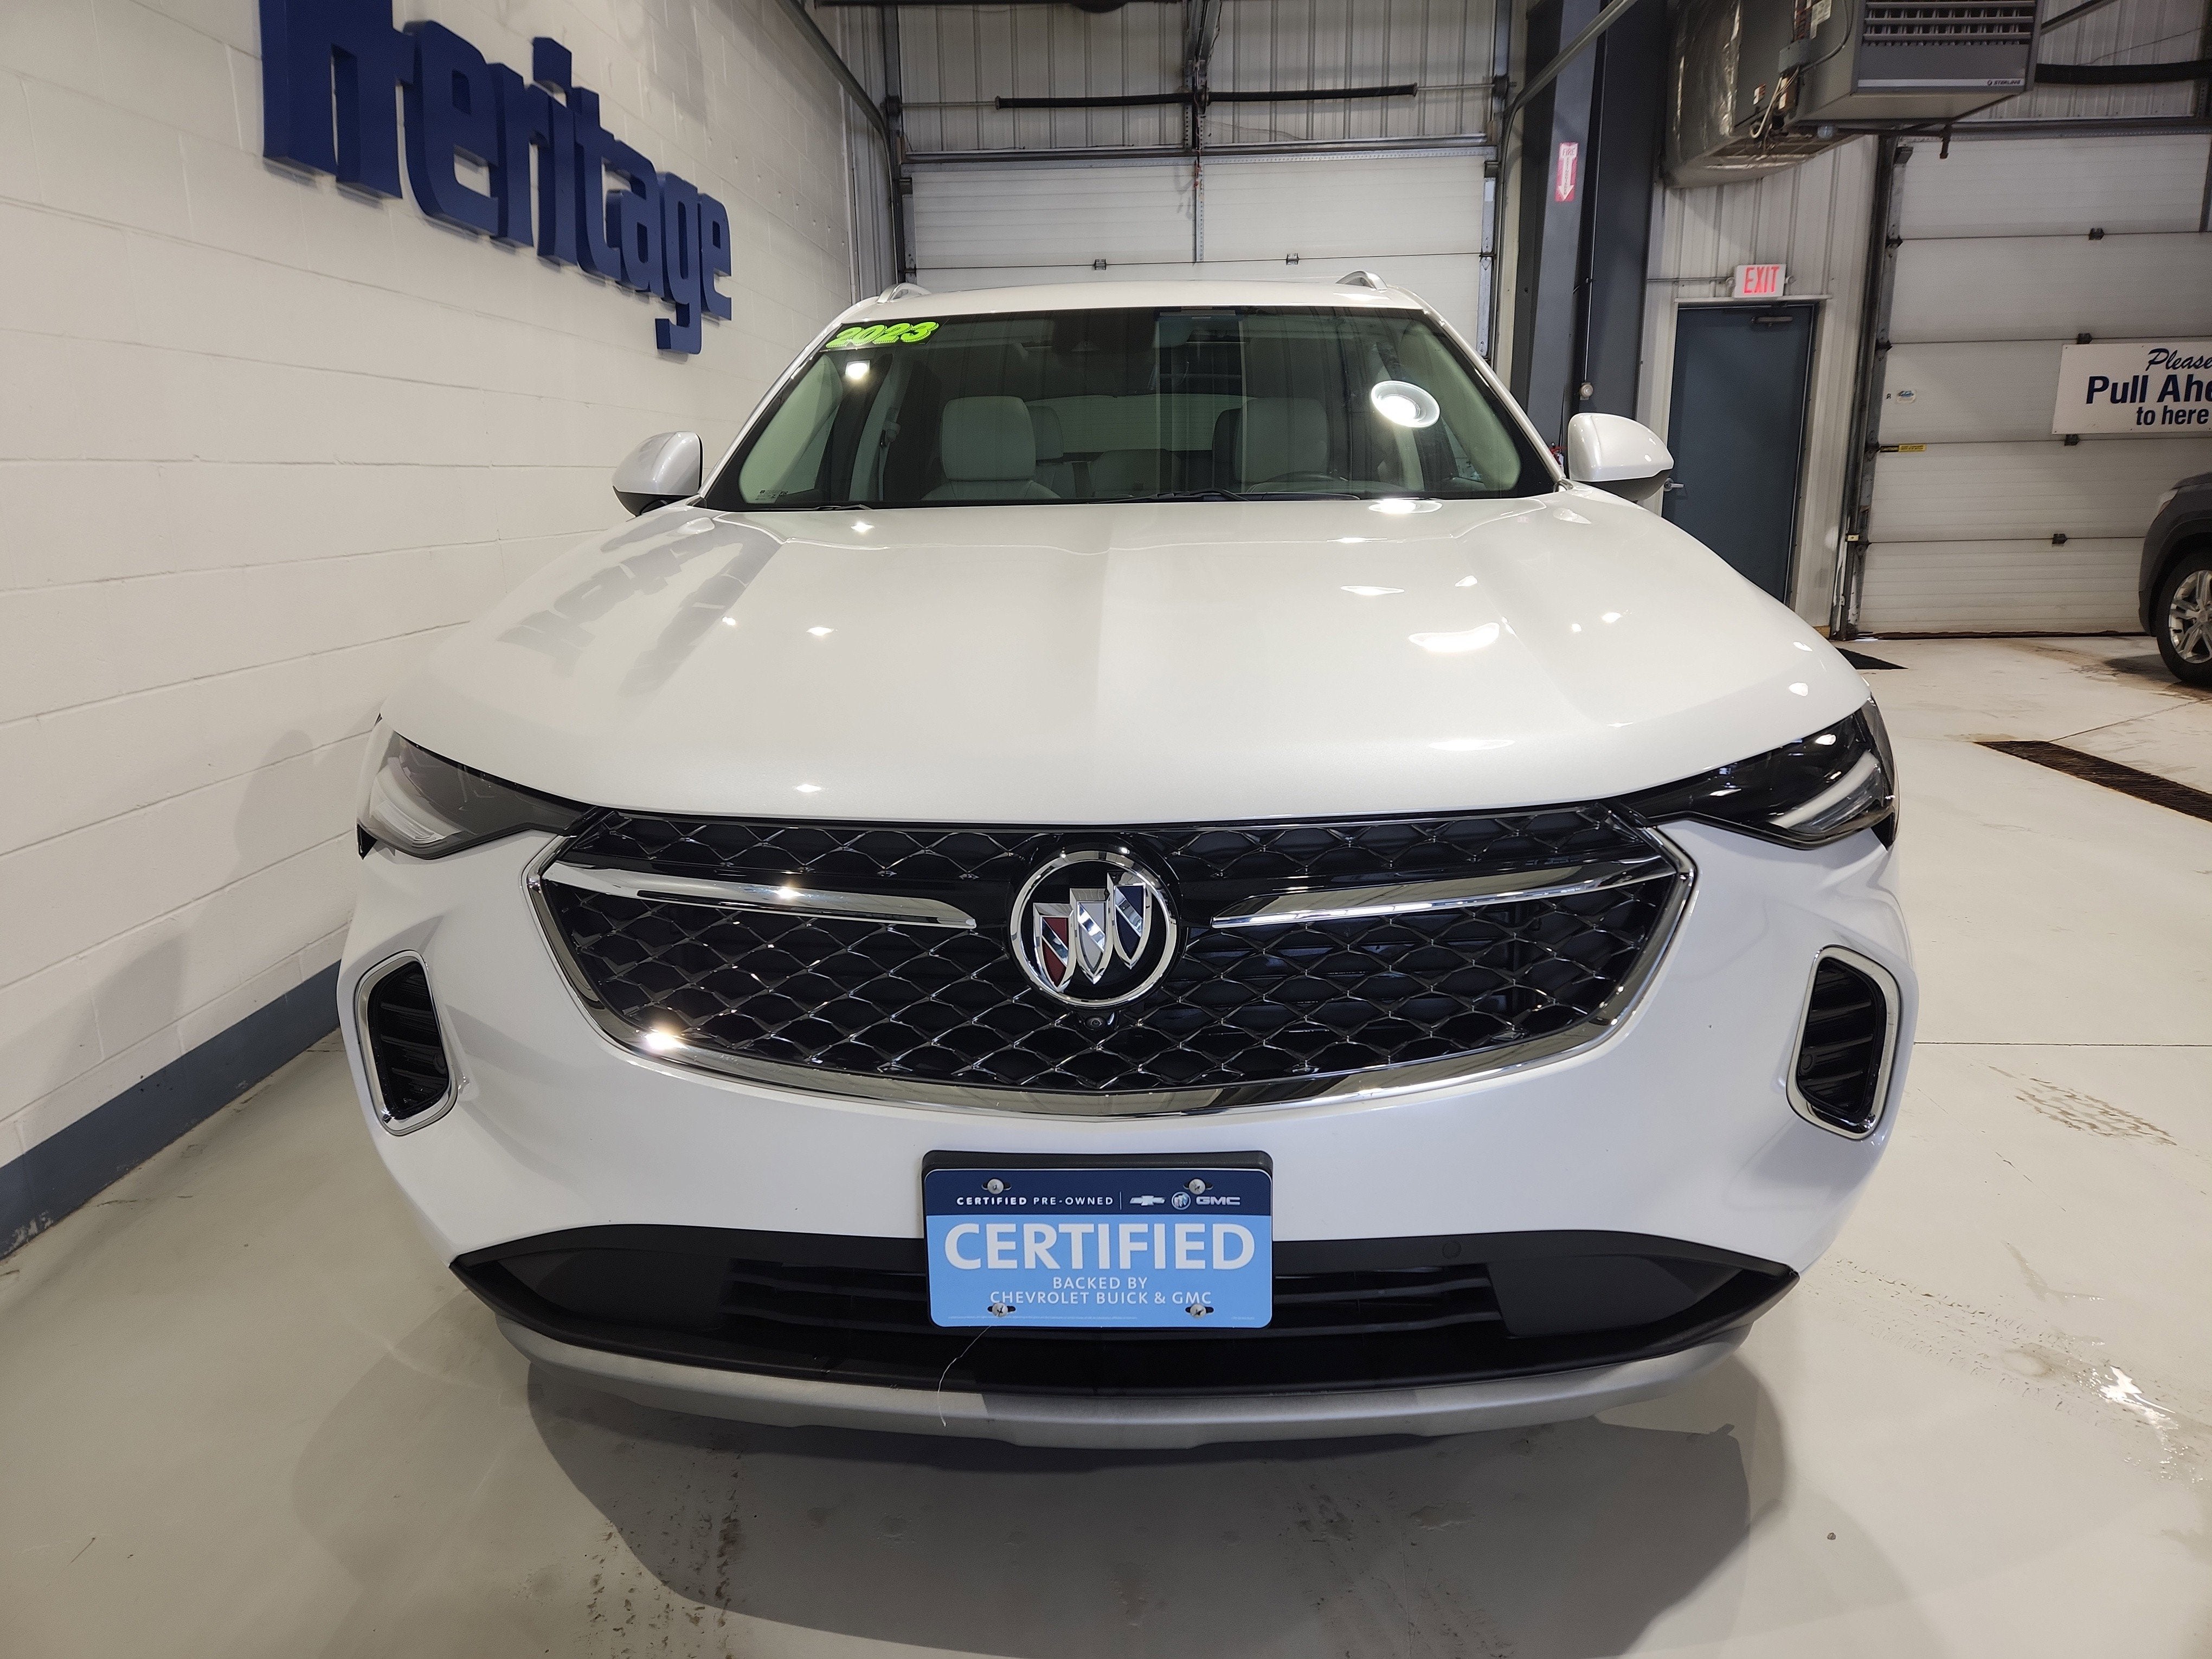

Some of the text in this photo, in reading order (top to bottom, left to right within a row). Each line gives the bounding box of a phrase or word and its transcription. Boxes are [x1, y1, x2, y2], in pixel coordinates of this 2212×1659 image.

[1562, 147, 1576, 156] FIRE
[1744, 265, 1780, 293] EXIT
[826, 321, 939, 348] 2023
[2086, 375, 2149, 404] Pull
[2136, 405, 2209, 425] to here
[956, 1196, 1240, 1205] CERTIFIED PRE-OWNED GMC
[944, 1223, 1255, 1270] CERTIFIED
[1053, 1277, 1148, 1289] BACKED BY
[990, 1291, 1212, 1304] CHEVROLET BUICK & GMC
